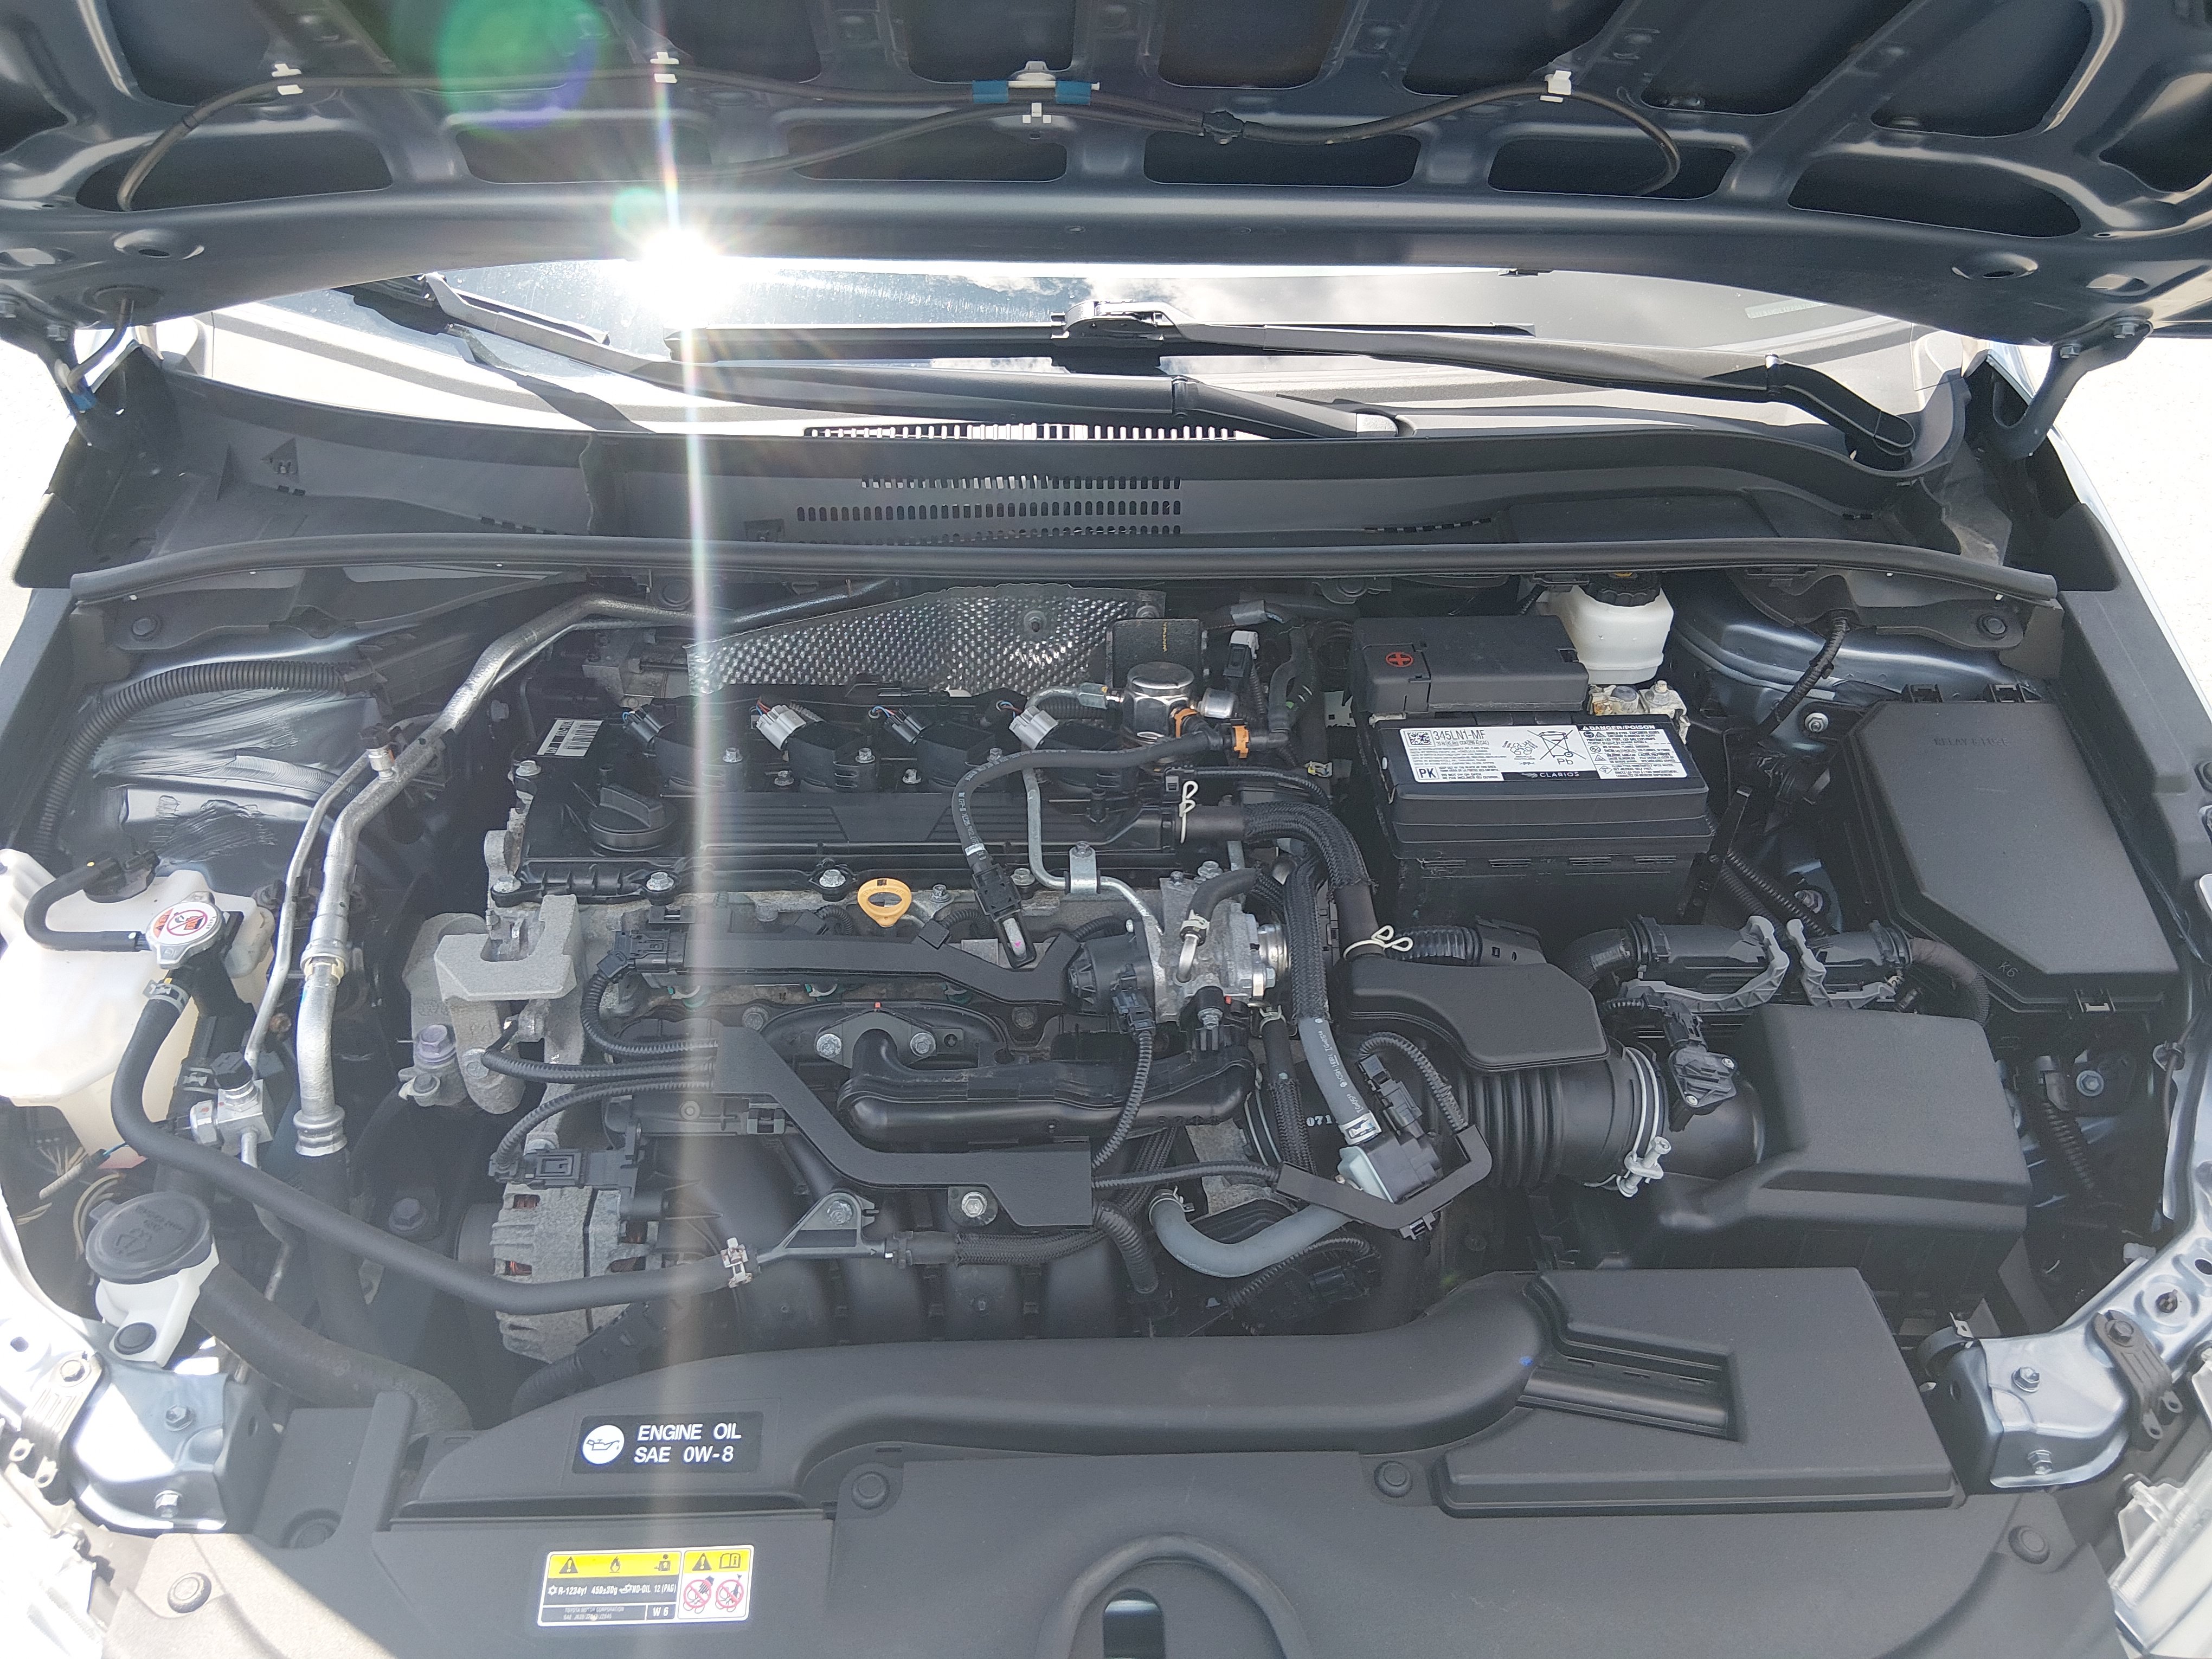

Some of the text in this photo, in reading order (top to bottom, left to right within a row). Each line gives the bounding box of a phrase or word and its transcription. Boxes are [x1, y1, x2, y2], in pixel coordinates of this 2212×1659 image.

[1432, 729, 1486, 741] 345LN1-MF
[1418, 768, 1437, 779] PK
[636, 1422, 742, 1442] ENGINE OIL
[633, 1445, 735, 1463] SAE 0W-8
[557, 1586, 588, 1597] R-1234yf
[654, 1584, 661, 1593] 12
[661, 1583, 677, 1594] (PAG)
[652, 1606, 669, 1617] W 6
